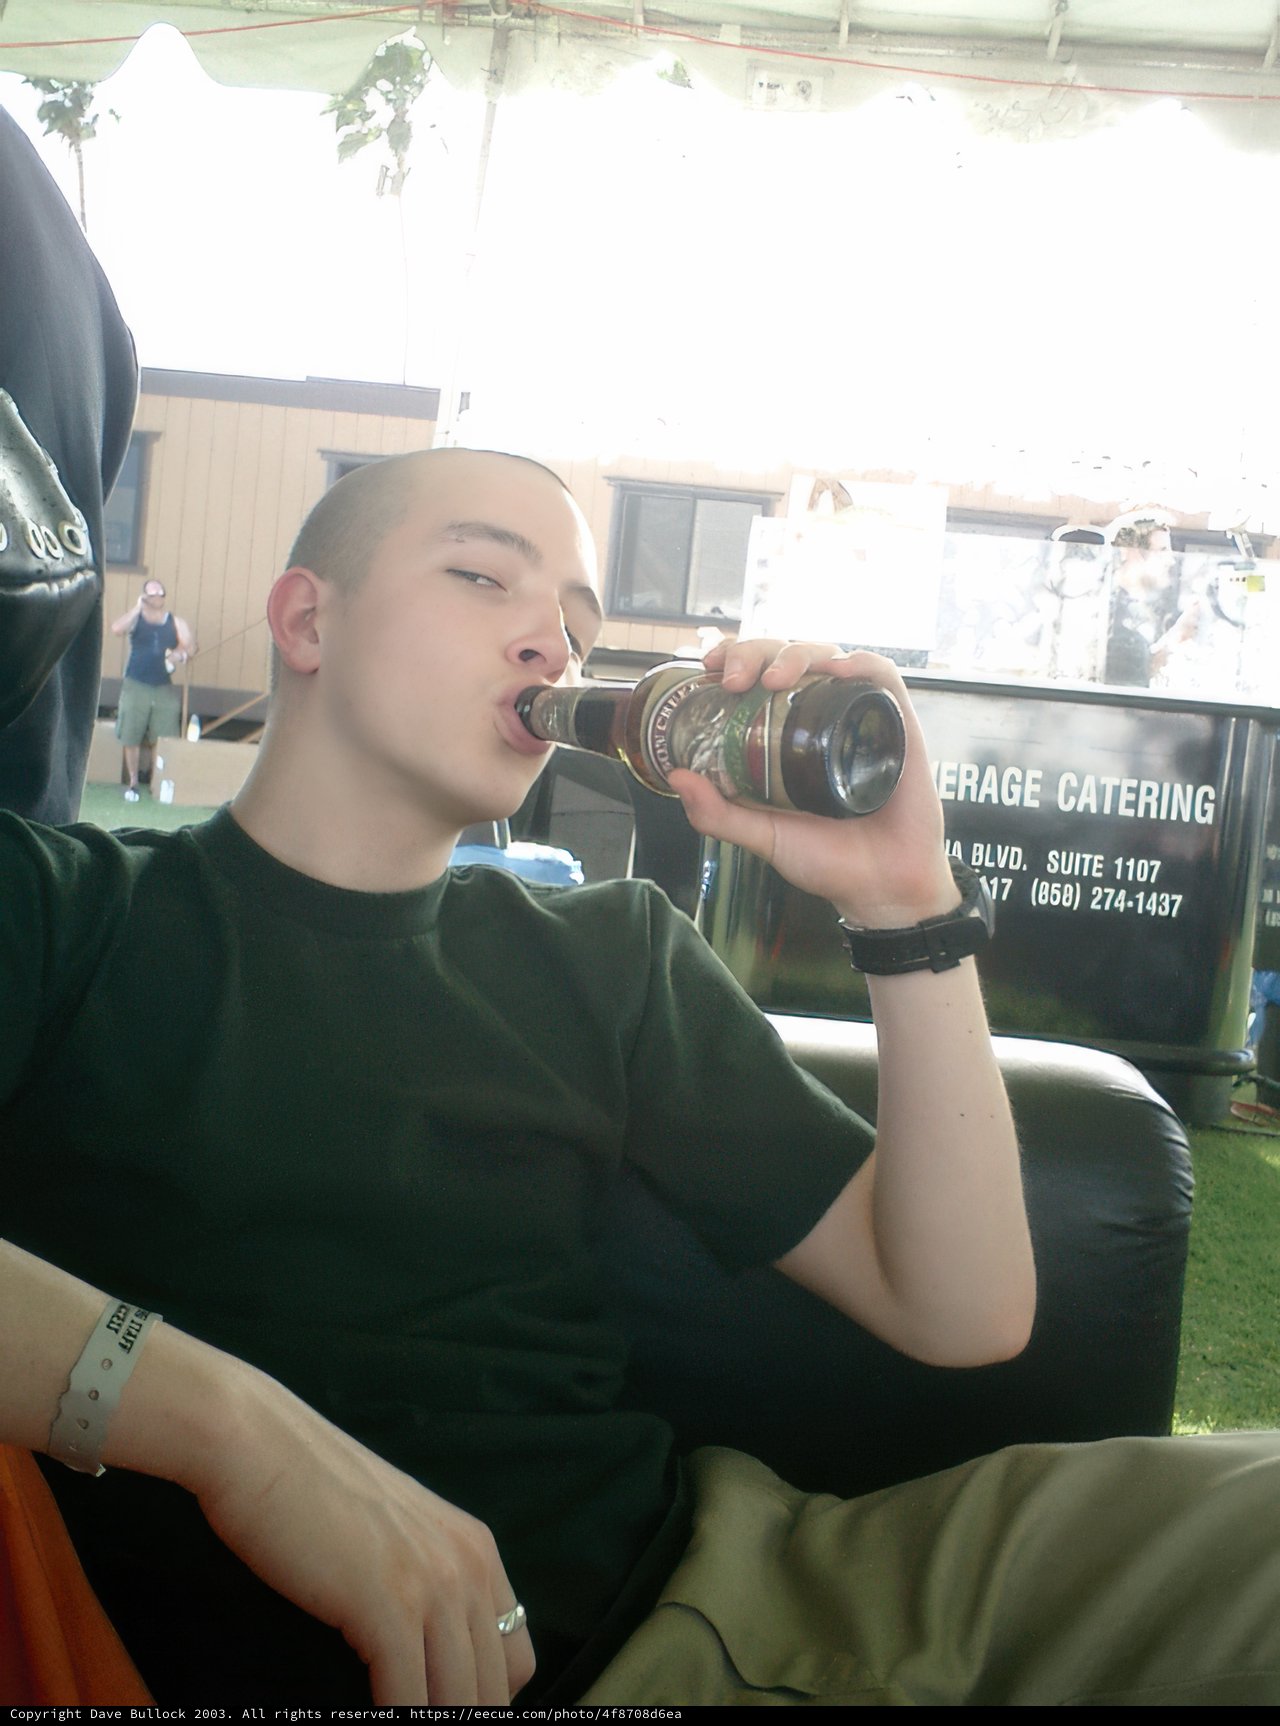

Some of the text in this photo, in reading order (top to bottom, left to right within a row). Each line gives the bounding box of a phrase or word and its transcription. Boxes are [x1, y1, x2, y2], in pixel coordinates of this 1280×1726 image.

[1057, 771, 1216, 825] CATERING
[971, 842, 1028, 872] BLVD.
[1046, 850, 1105, 878] SUITE
[1114, 856, 1162, 884] 1107
